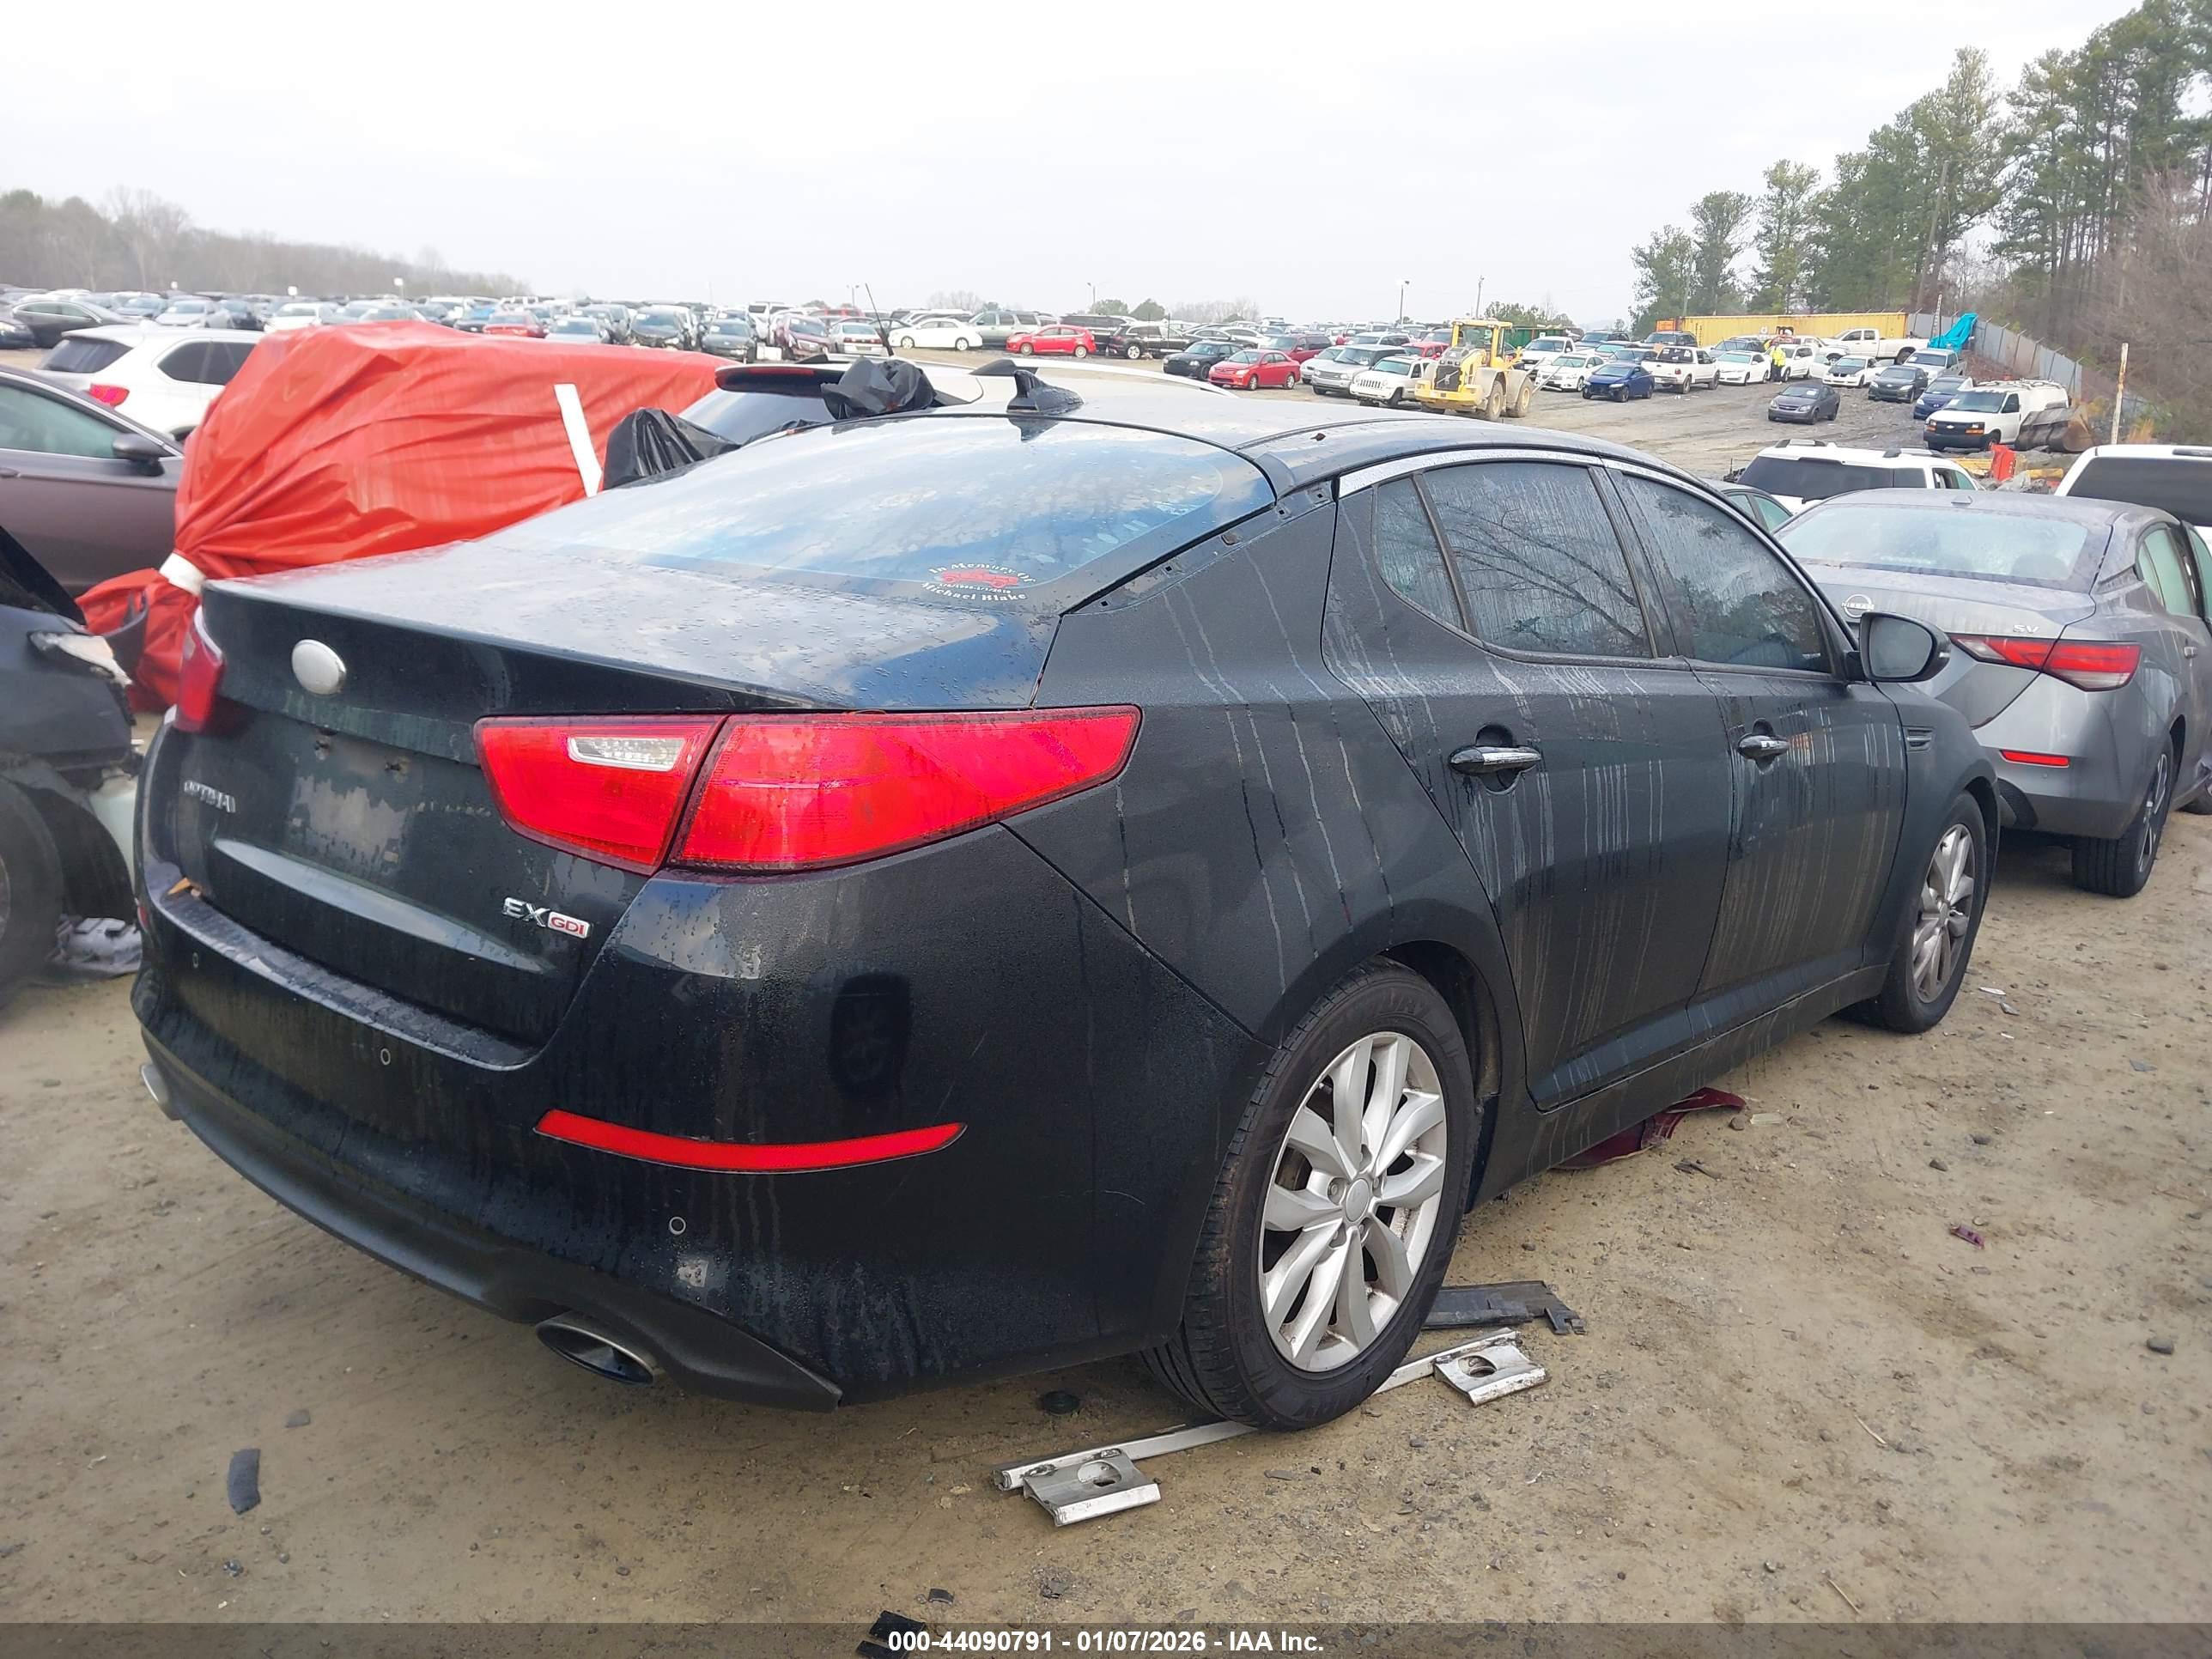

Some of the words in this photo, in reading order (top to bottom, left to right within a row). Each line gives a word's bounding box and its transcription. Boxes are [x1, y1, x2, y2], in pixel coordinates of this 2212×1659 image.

[951, 562, 1015, 574] Memory
[921, 582, 976, 600] Michael
[2013, 624, 2040, 634] SV
[502, 897, 550, 927] EX
